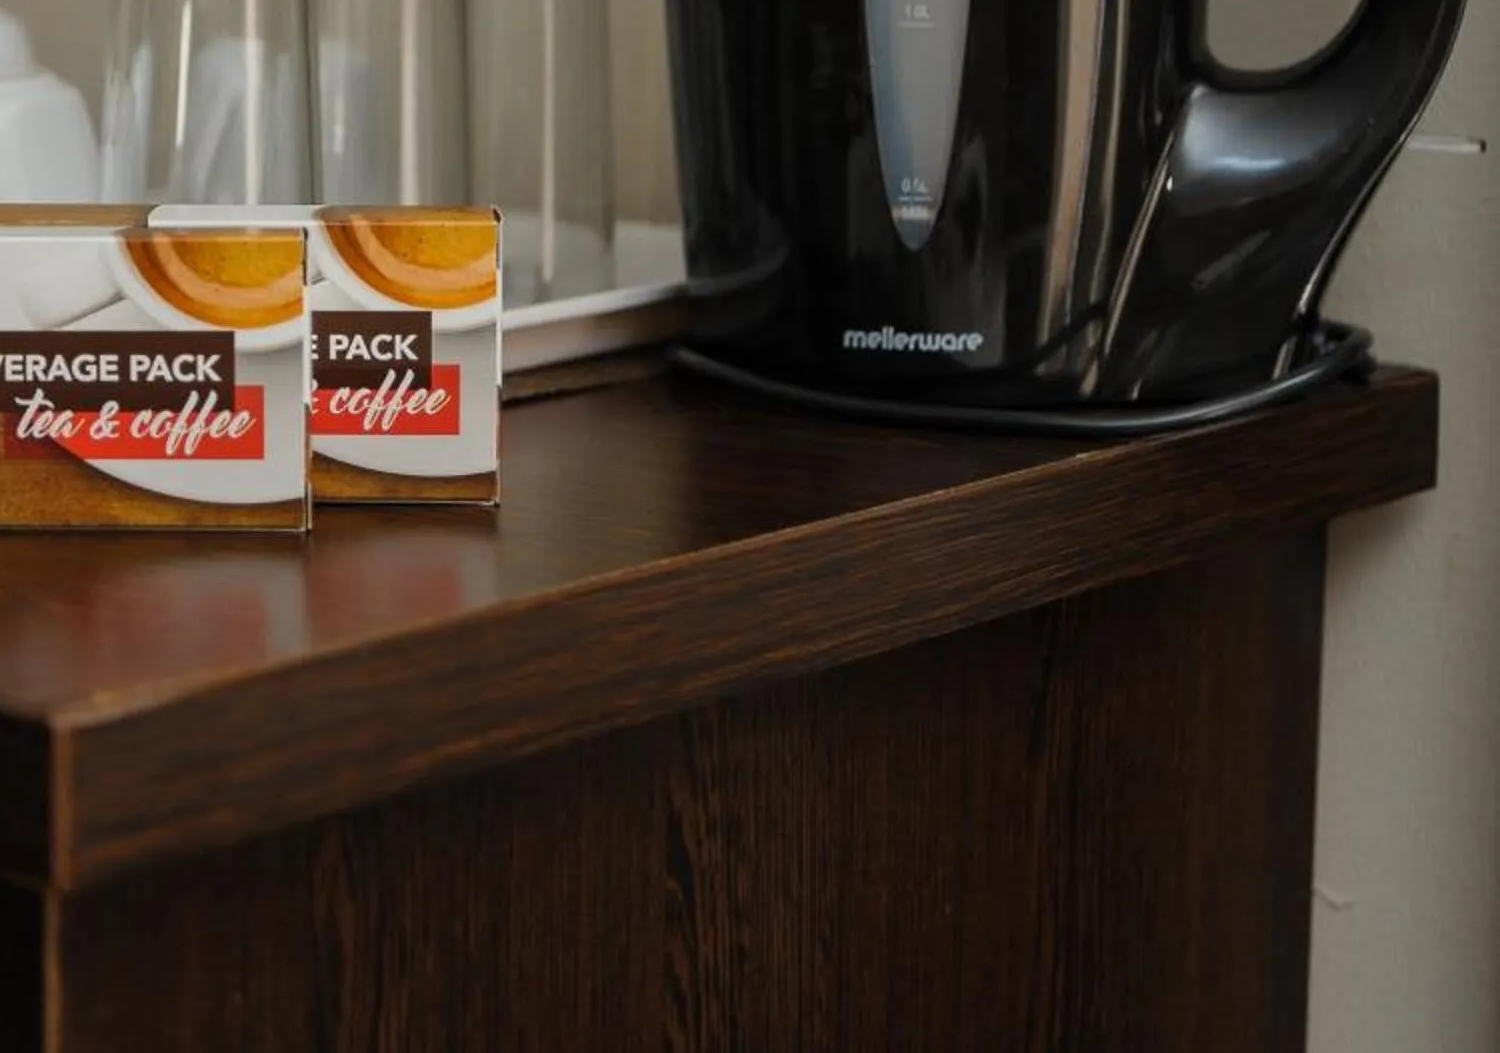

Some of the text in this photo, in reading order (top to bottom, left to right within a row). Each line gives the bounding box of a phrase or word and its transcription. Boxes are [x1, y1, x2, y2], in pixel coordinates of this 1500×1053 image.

[905, 3, 931, 19] 10L
[329, 333, 419, 361] PACK
[843, 325, 984, 352] mellerware
[129, 354, 222, 383] PACK
[329, 367, 451, 432] coffee
[14, 387, 86, 439] tea
[89, 400, 120, 439] &
[130, 389, 257, 456] coffee
